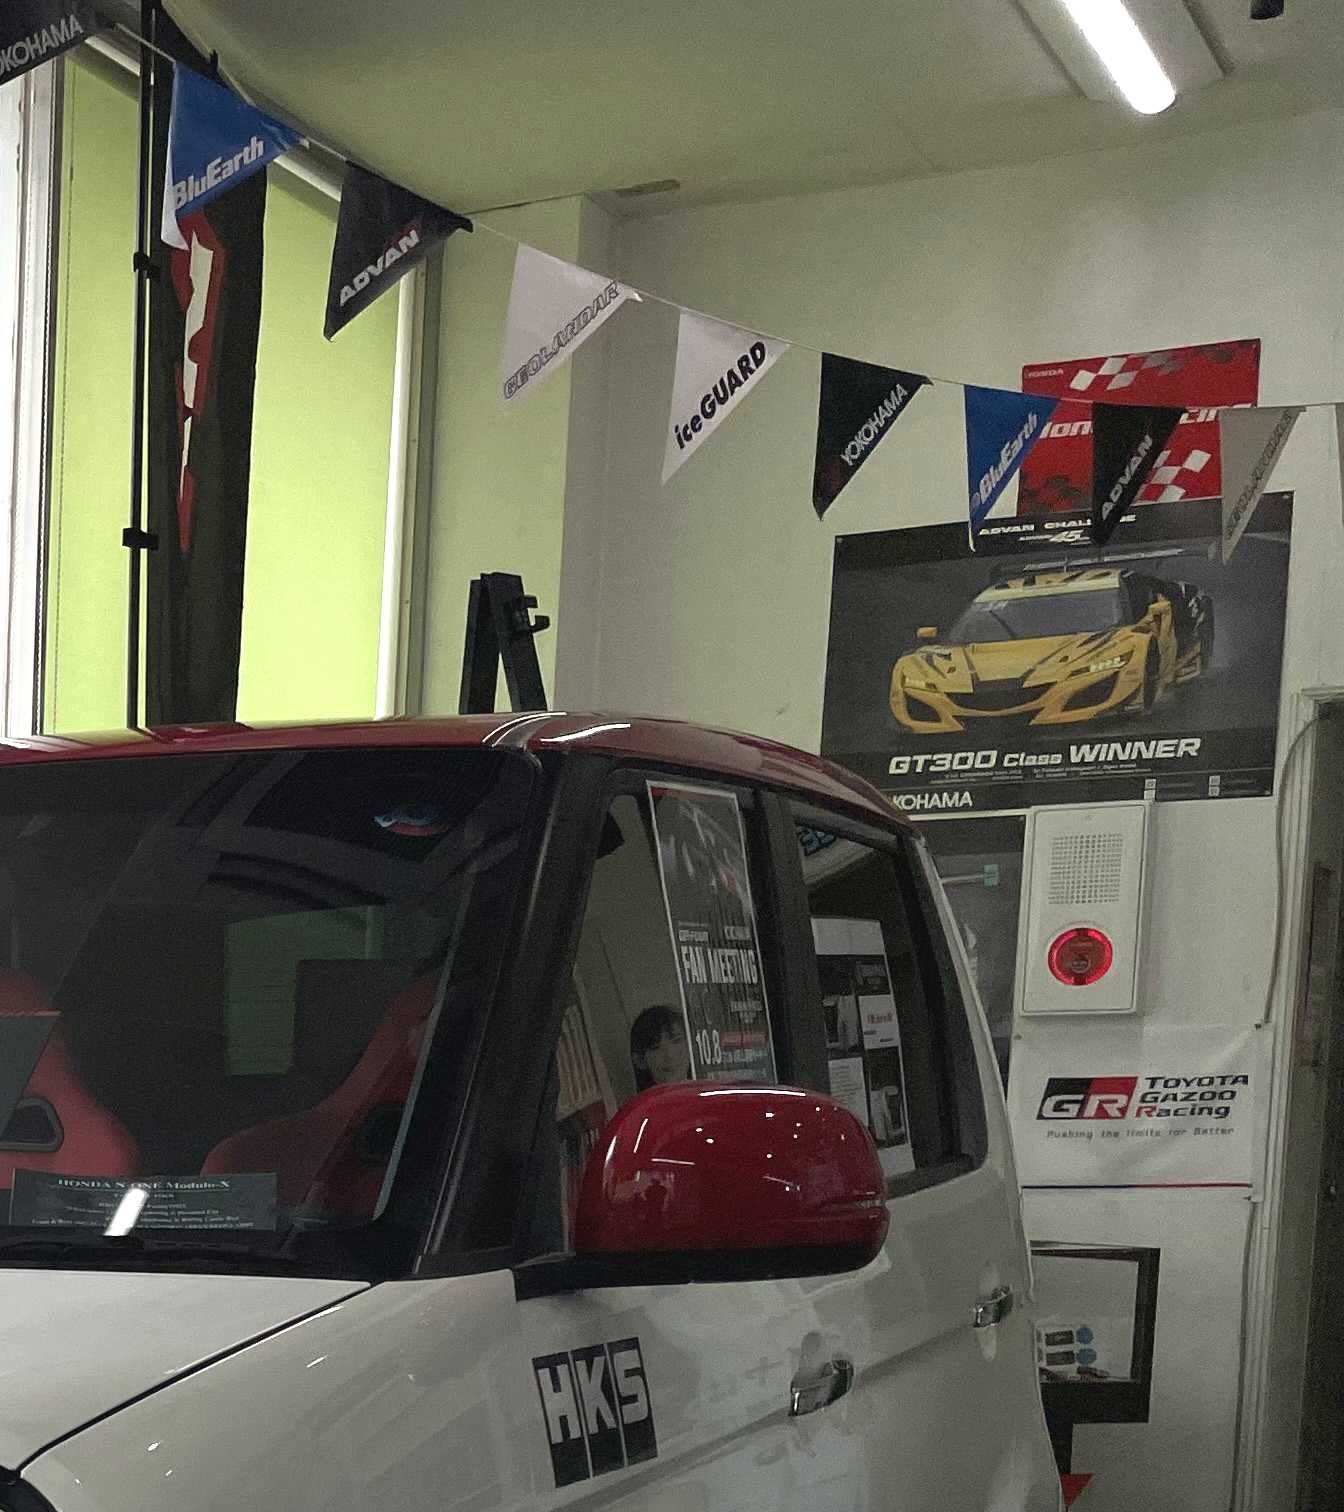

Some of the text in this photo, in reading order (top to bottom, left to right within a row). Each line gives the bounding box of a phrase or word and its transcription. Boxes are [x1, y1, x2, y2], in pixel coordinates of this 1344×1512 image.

[173, 137, 264, 210] BluEarth
[339, 230, 421, 306] ADVAN
[674, 341, 768, 450] iceGUARD
[840, 383, 909, 466] YOKOHAMA
[979, 411, 1039, 504] BluEarth
[1101, 434, 1154, 521] ADVAN
[888, 749, 999, 775] GT300
[1003, 752, 1063, 768] Class
[1069, 738, 1202, 764] WINNER
[889, 791, 974, 811] KOHAMA
[681, 946, 708, 984] FAN
[1039, 1090, 1129, 1119] GR
[1139, 1089, 1237, 1104] GAZOO
[1145, 1074, 1249, 1089] TOYOTA
[1135, 1103, 1231, 1120] Racing
[535, 1345, 652, 1452] HKS
